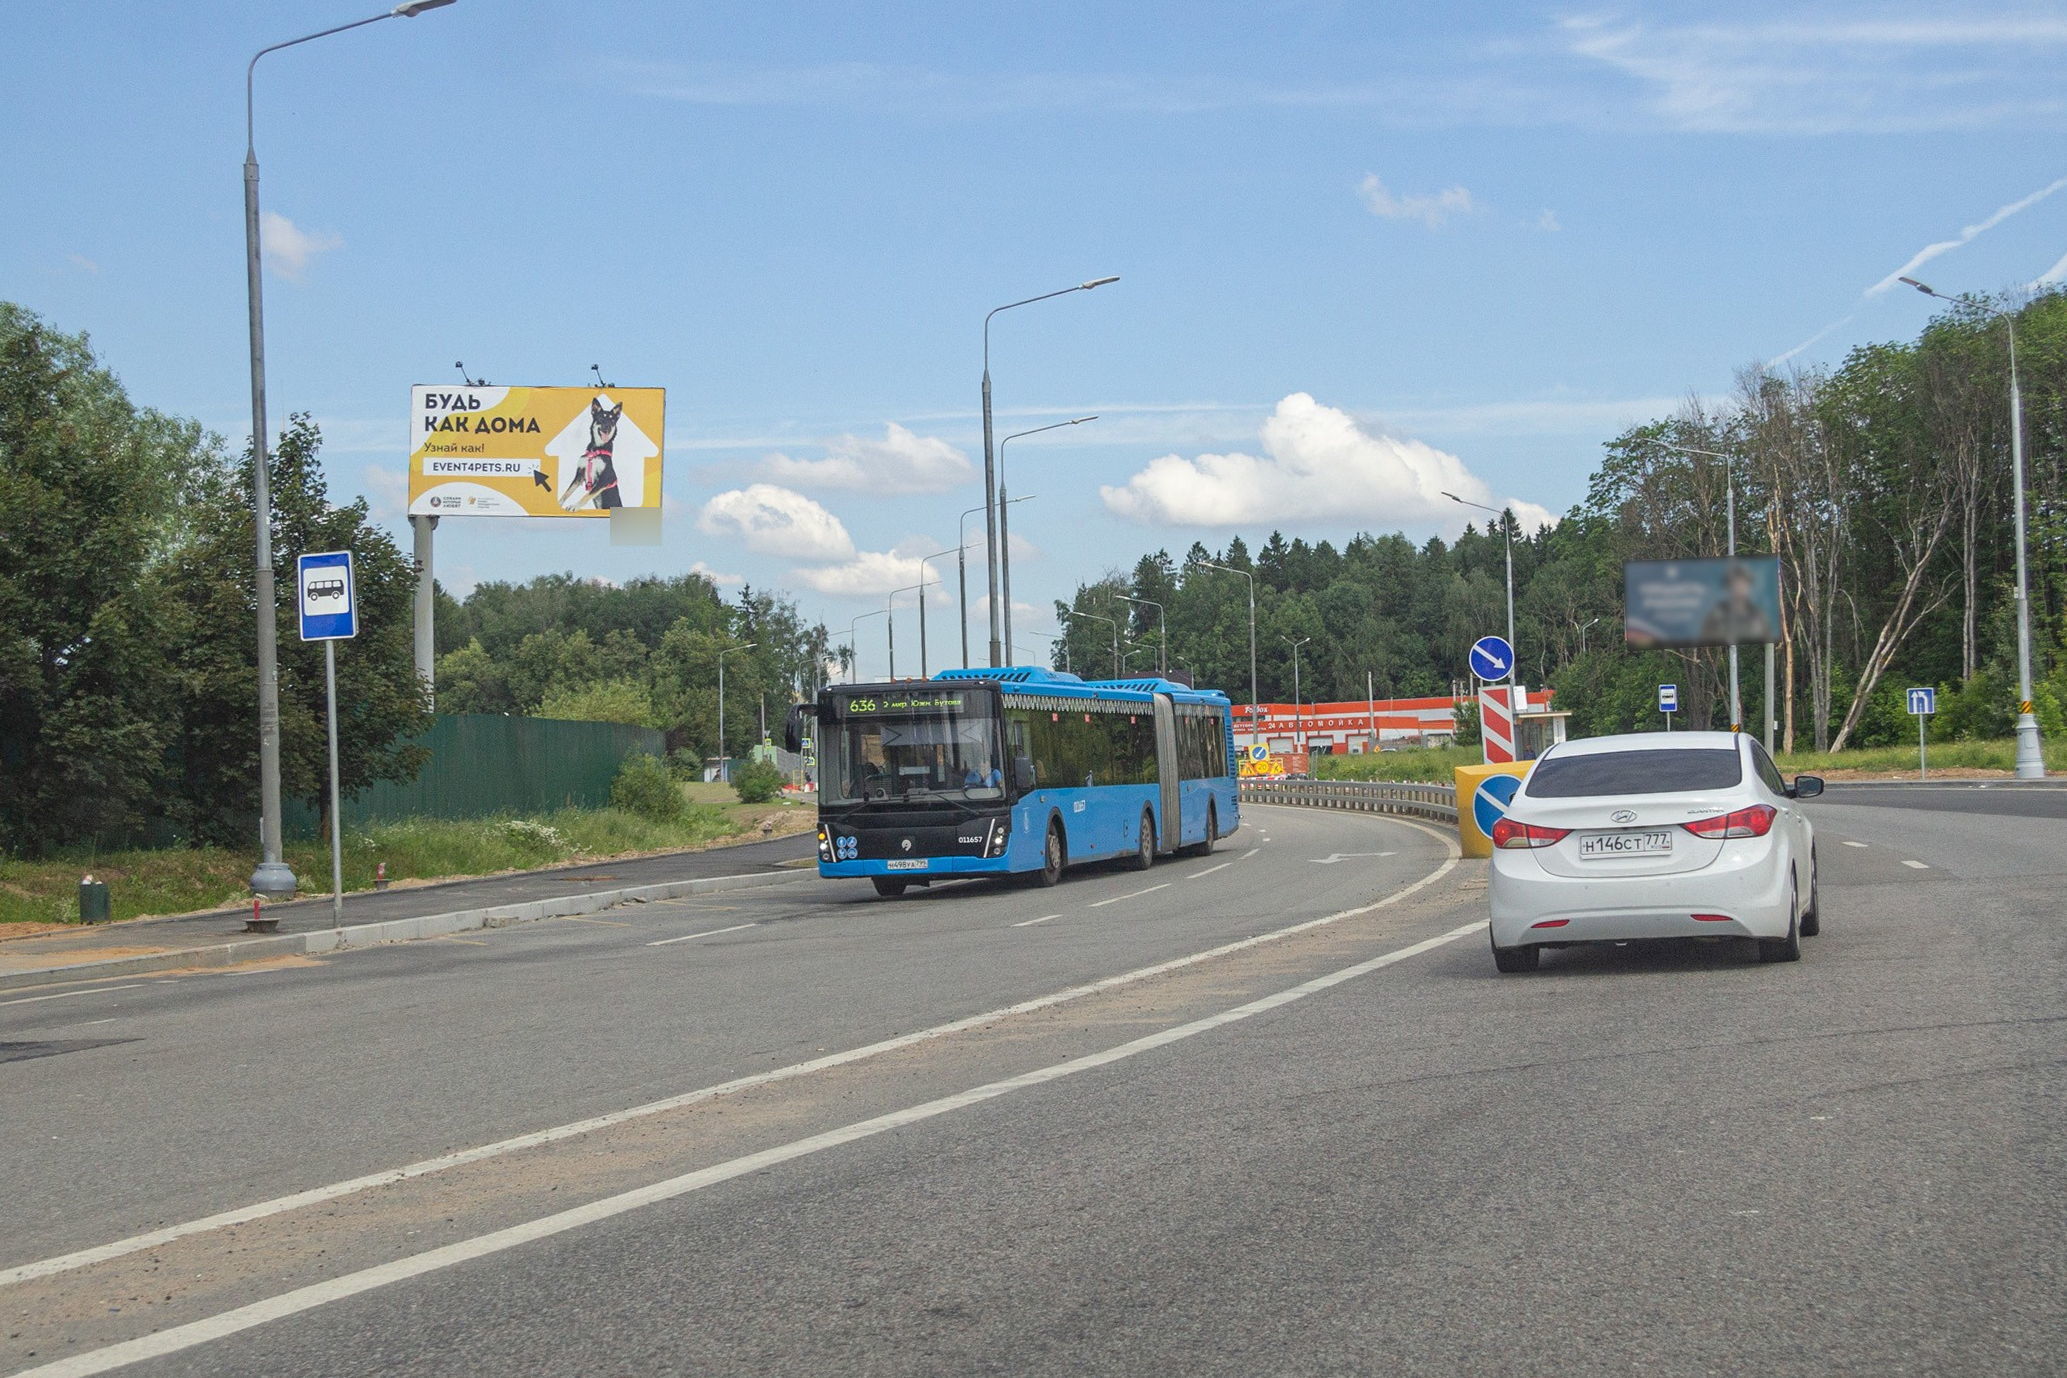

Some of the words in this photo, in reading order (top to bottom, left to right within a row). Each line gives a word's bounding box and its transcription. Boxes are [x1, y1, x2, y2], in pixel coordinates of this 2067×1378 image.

[425, 393, 481, 411] БУДЬ
[425, 416, 469, 432] КАК
[475, 417, 541, 434] ДОМА
[424, 442, 457, 453] Узнай
[461, 443, 485, 453] как!
[433, 462, 521, 472] EVENT4PETS.RU
[850, 699, 876, 712] 636
[1278, 719, 1364, 729] АВТОМОЙКА
[1585, 837, 1642, 852] Н146СТ
[1645, 833, 1668, 845] 777
